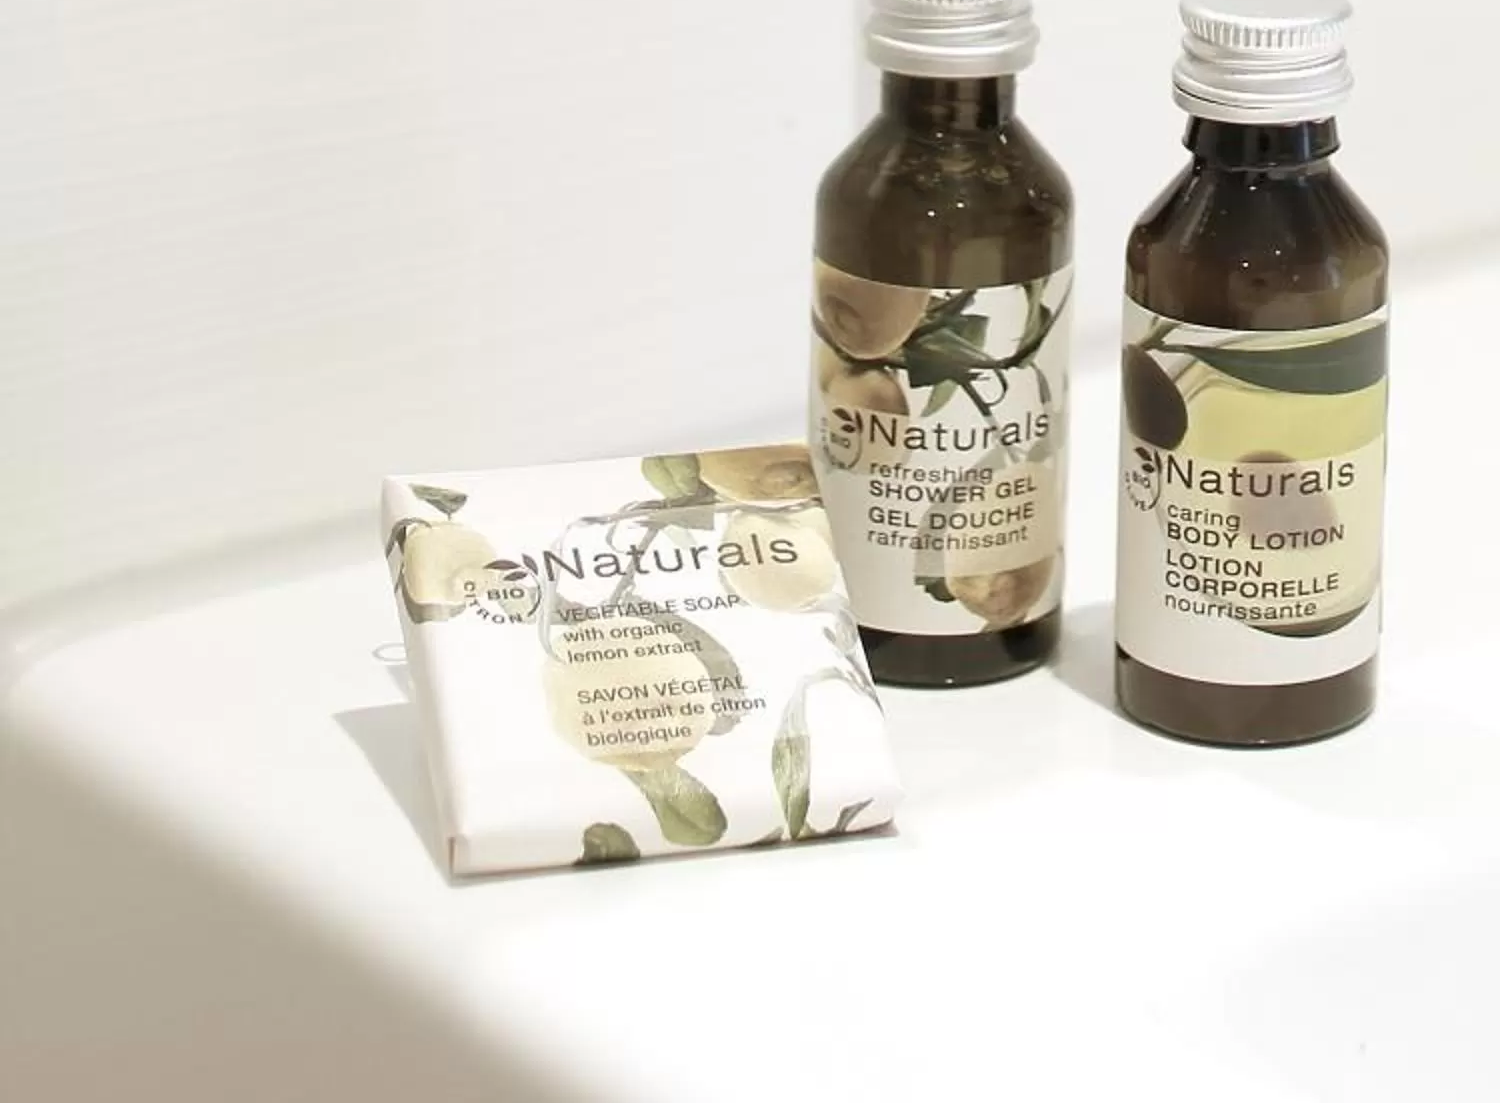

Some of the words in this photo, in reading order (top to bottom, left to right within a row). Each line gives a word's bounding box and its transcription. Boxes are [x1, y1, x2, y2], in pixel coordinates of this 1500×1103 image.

[869, 411, 1050, 451] Naturals
[870, 461, 994, 485] refreshing
[1166, 453, 1356, 497] Naturals
[869, 479, 986, 504] SHOWER
[995, 476, 1037, 499] GEL
[867, 506, 918, 529] GEL
[929, 501, 1035, 530] DOUCHE
[1167, 503, 1241, 531] caring
[867, 525, 1028, 552] rafraîchissant
[1167, 521, 1240, 549] BODY
[1250, 524, 1345, 550] LOTION
[542, 533, 799, 582] Naturals
[1166, 548, 1263, 578] LOTION
[487, 588, 525, 600] BIO
[1165, 570, 1340, 599] CORPORELLE
[463, 580, 523, 624] CITRON
[558, 598, 680, 623] VEGETABLE
[683, 593, 742, 613] SOAP
[1164, 594, 1317, 621] nourrissante
[563, 625, 604, 643] with
[610, 621, 684, 641] organic
[566, 647, 629, 664] lemon
[634, 639, 704, 658] extract
[577, 684, 649, 704] SAVON
[653, 675, 748, 698] VÉGÉTAL
[583, 711, 595, 726] à
[600, 704, 674, 724] l'extrait
[680, 702, 705, 716] de
[711, 696, 767, 714] citron
[587, 725, 693, 747] biologique
